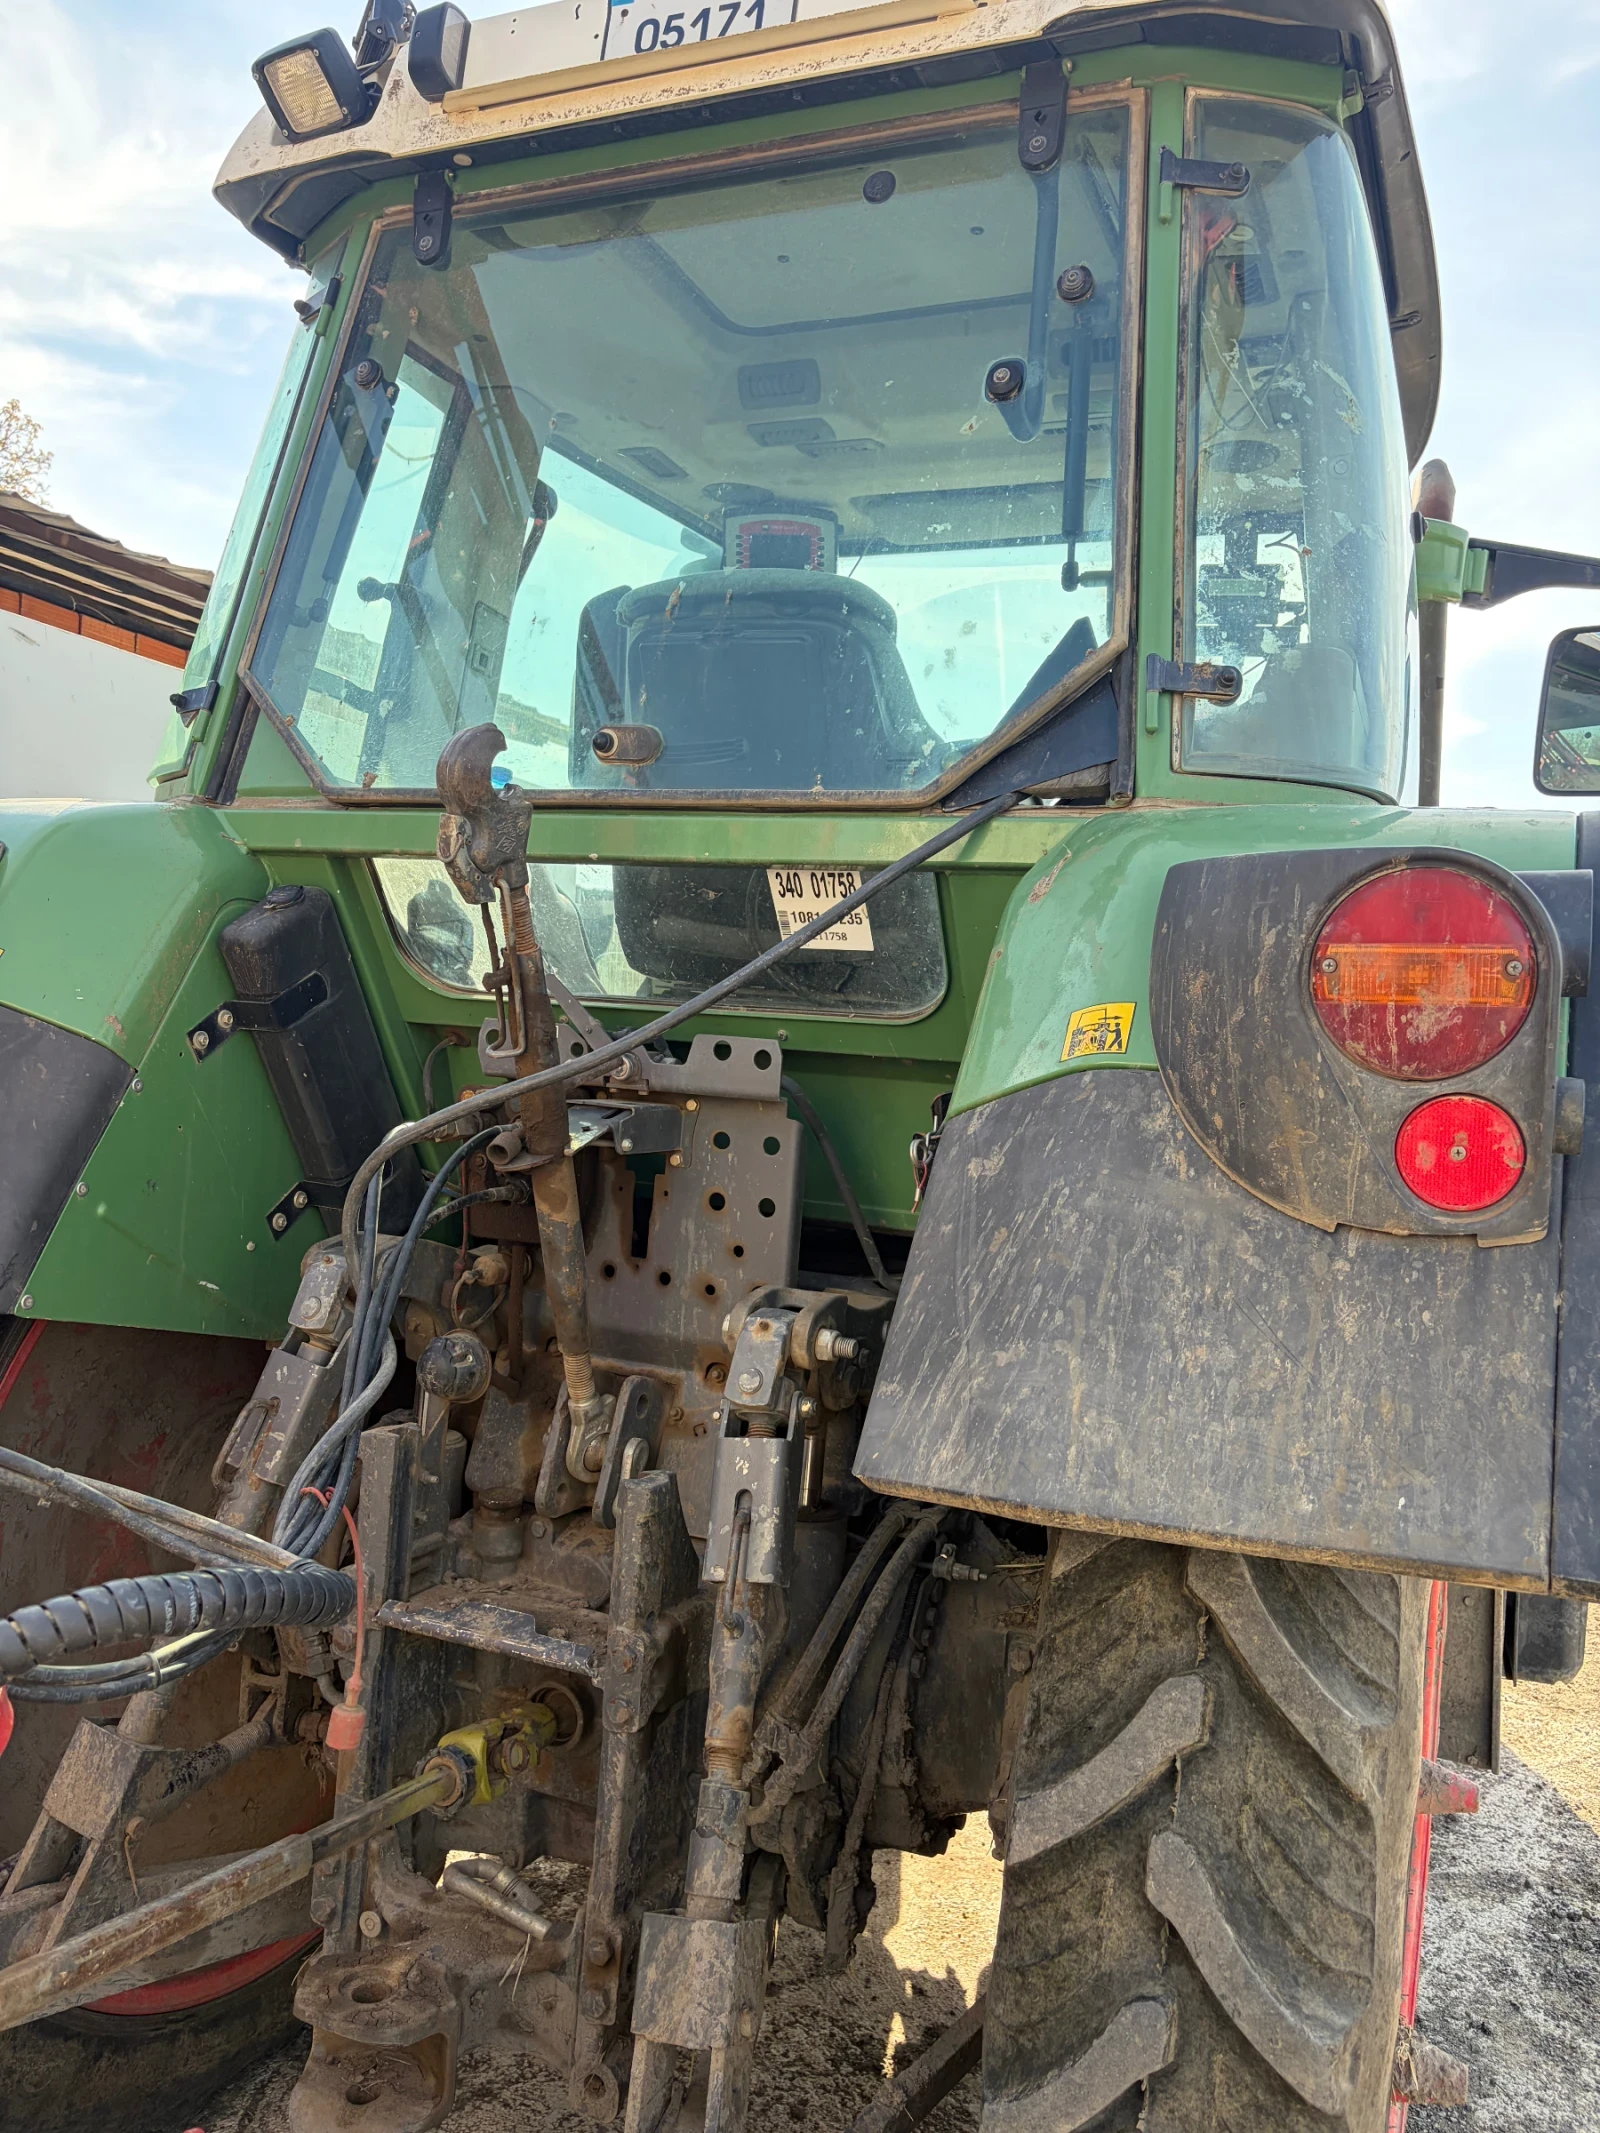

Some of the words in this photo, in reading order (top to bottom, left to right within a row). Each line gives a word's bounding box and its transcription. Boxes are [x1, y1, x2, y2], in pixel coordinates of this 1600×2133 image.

[634, 0, 765, 54] 05171
[775, 871, 803, 898] 340
[810, 871, 857, 898] 01758
